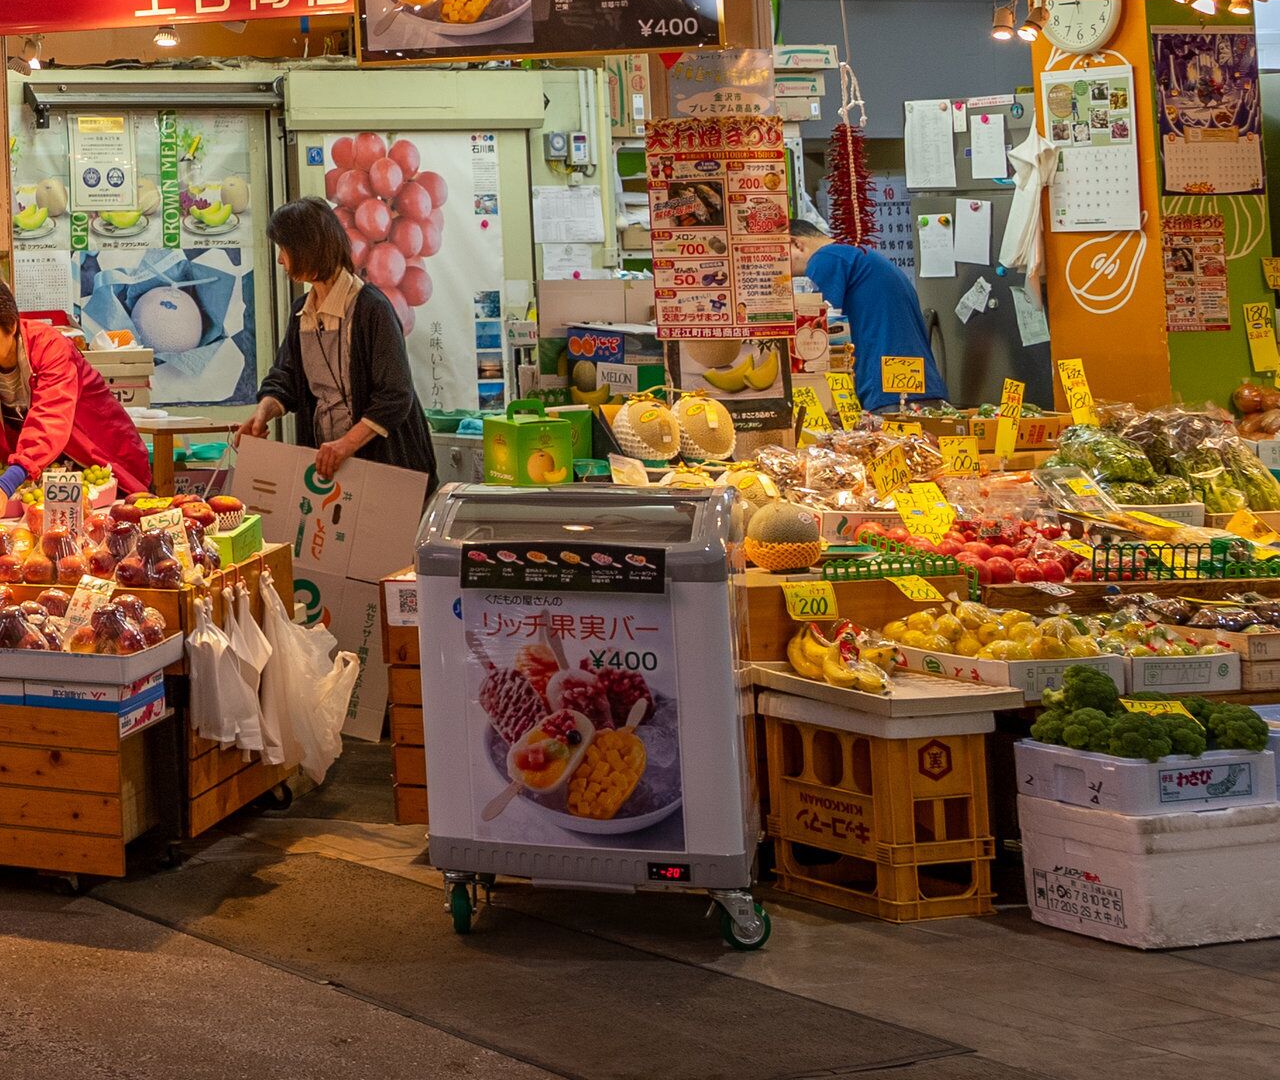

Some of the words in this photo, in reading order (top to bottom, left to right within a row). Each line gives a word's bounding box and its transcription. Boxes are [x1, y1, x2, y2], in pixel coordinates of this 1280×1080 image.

[1047, 0, 1055, 11] 9
[1053, 15, 1060, 26] 8
[1099, 12, 1106, 23] 4
[638, 17, 699, 37] ¥400
[1064, 26, 1071, 37] 7
[1090, 24, 1097, 36] 5
[1076, 29, 1084, 41] 6
[714, 92, 743, 102] 金沢市
[688, 103, 762, 114] プレミアム商品券
[883, 187, 895, 200] 10
[161, 179, 180, 248] CROWN
[662, 312, 729, 322] 交流プラザまつり
[671, 327, 751, 337] 近江町市場商店街
[884, 358, 917, 367] ピーマン
[599, 369, 633, 385] MELON
[45, 483, 82, 502] 650
[310, 518, 326, 561] メロン
[484, 595, 563, 608] くだもの屋さんの
[483, 611, 659, 642] リッチ果実バー
[589, 649, 658, 671] ¥400
[1175, 769, 1213, 788] わさび
[799, 791, 863, 816] KIKKOMAN
[796, 808, 871, 845] キッコーマン
[1093, 910, 1102, 921] 大
